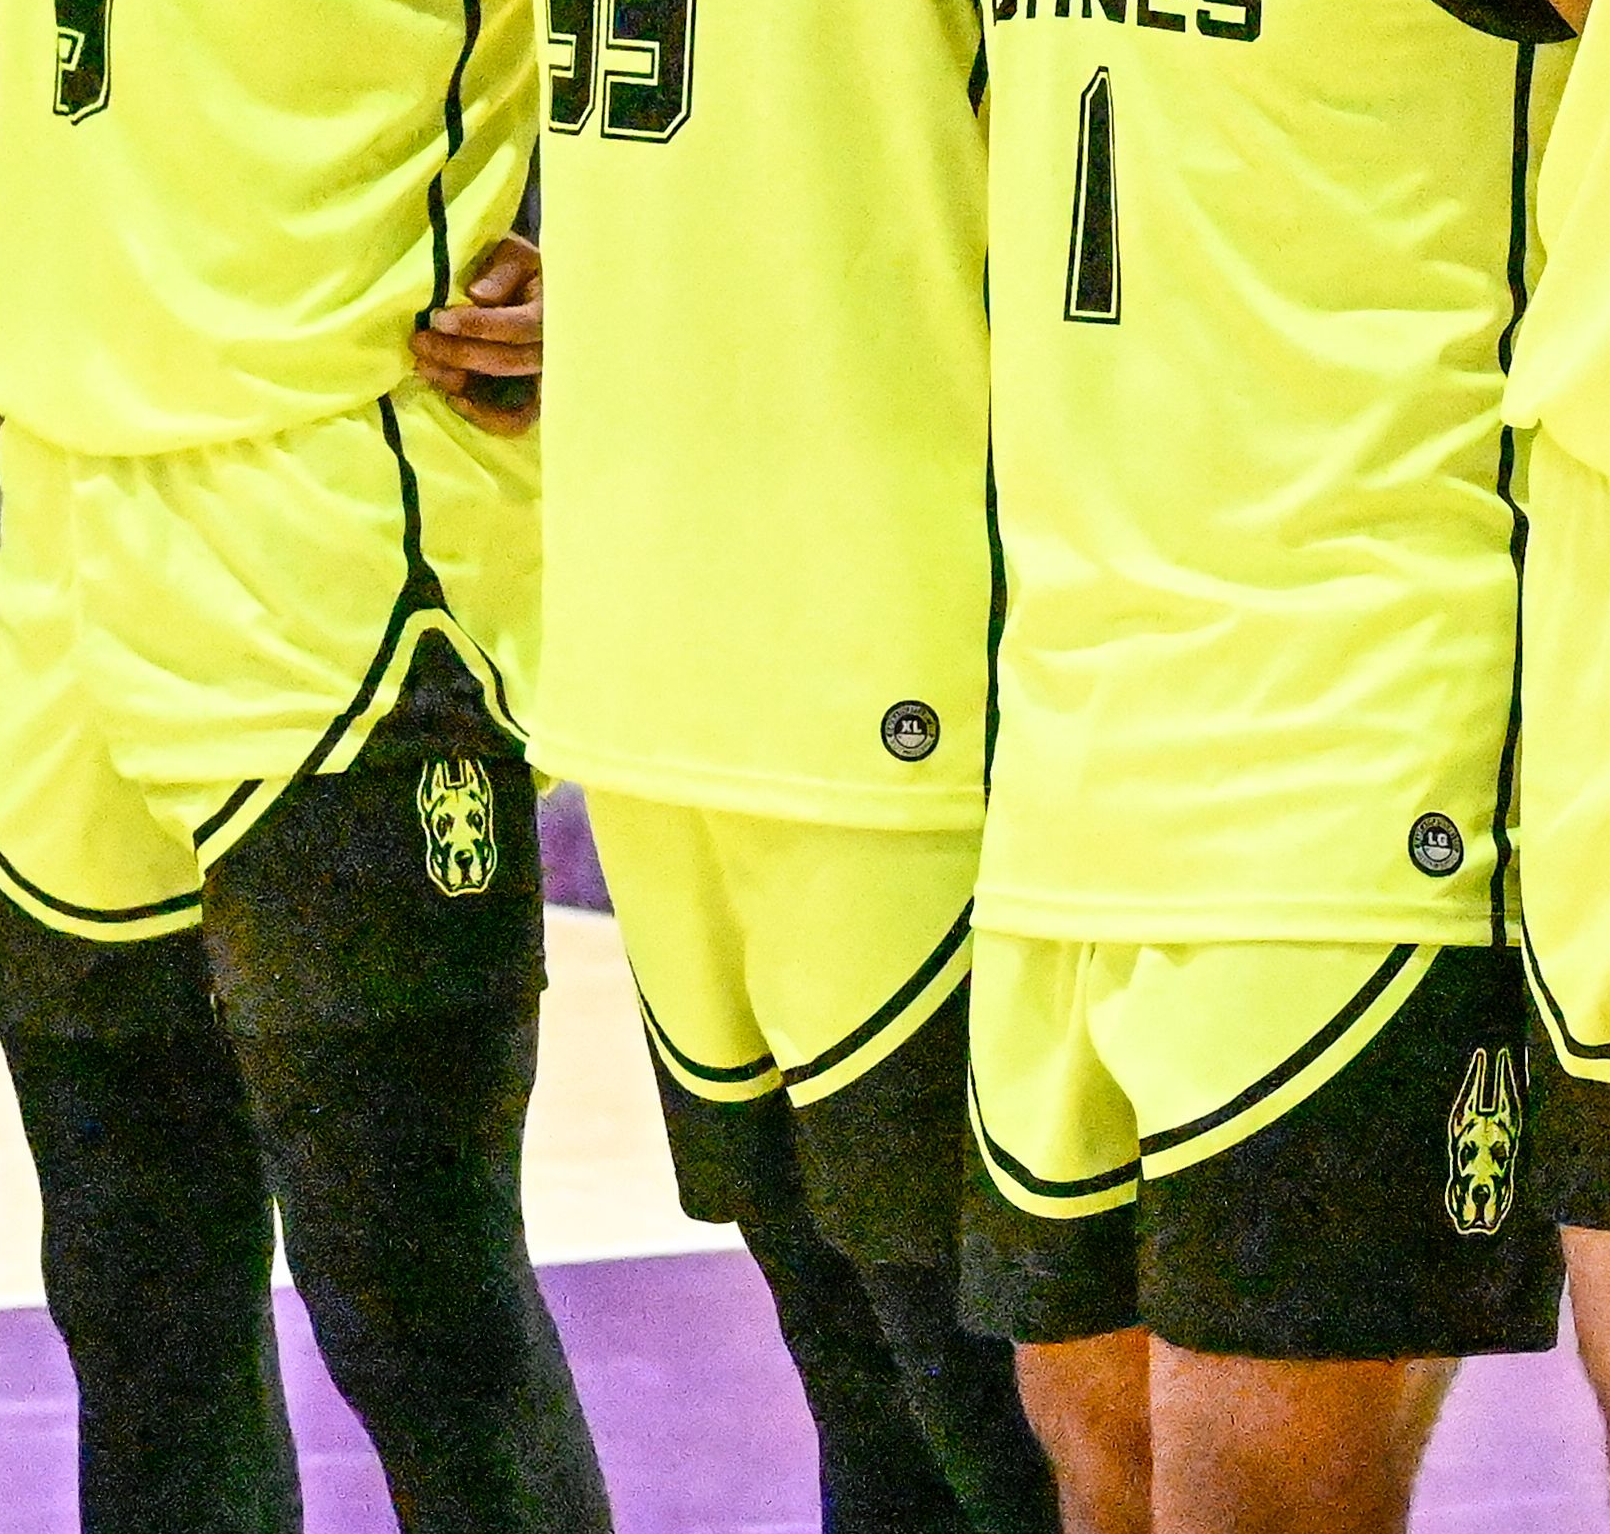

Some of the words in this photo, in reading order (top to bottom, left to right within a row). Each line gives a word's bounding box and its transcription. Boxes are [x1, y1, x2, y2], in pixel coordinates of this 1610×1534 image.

[1063, 65, 1121, 325] 1
[900, 719, 923, 734] XL
[1427, 830, 1449, 847] LG
